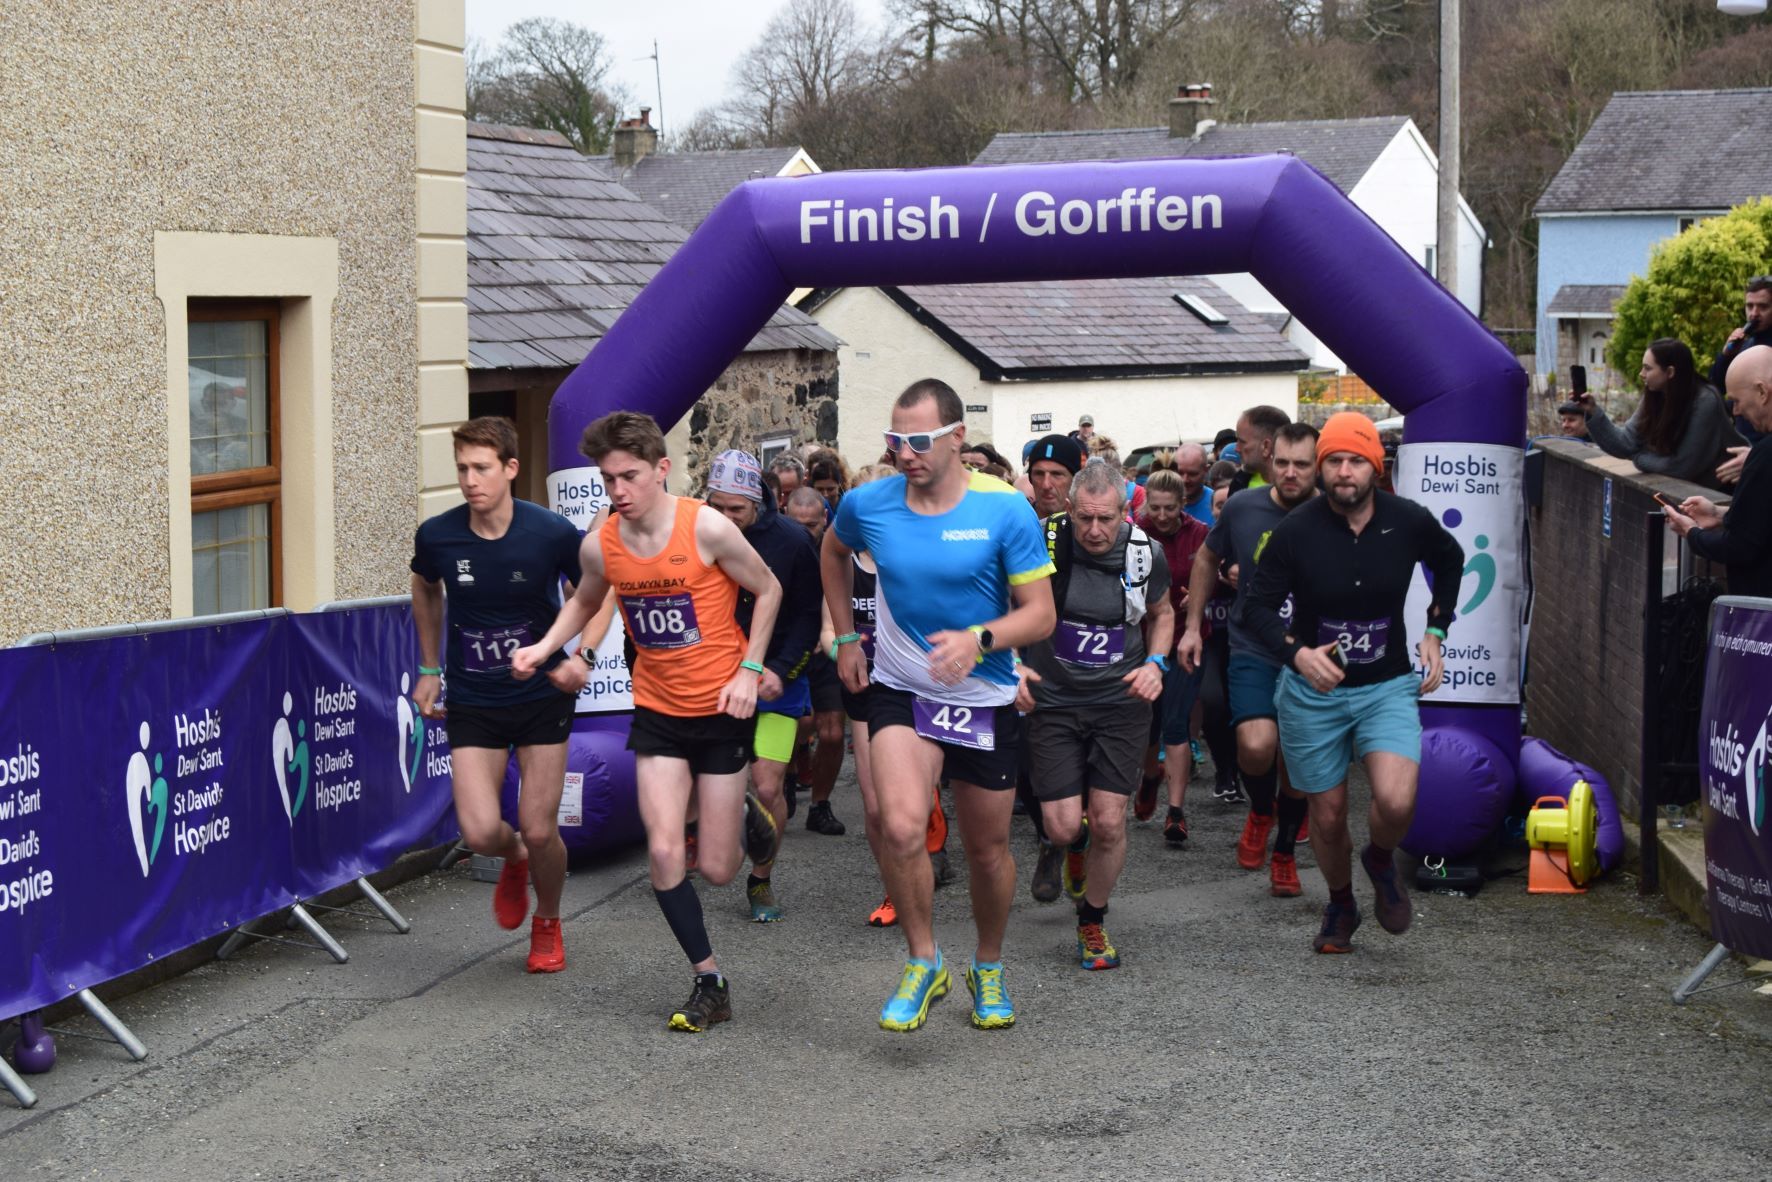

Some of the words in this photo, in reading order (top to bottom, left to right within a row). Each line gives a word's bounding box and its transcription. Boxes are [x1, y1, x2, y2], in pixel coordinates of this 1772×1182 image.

[800, 196, 960, 244] Finish
[979, 192, 998, 243] /
[1014, 187, 1223, 237] Gorffen
[1424, 455, 1497, 477] Hosbis
[1421, 478, 1459, 493] Dewi
[1464, 479, 1500, 496] Sant
[557, 501, 585, 517] Dewi
[619, 579, 661, 591] COLWYN
[664, 577, 686, 588] BAY
[634, 609, 686, 634] 108
[471, 639, 521, 661] 112
[1076, 631, 1109, 655] 72
[1337, 633, 1372, 653] 34
[1412, 663, 1496, 690] Hspice
[315, 682, 357, 716] Hosbis
[174, 708, 221, 748] Hosbis
[314, 720, 334, 742] Dewi
[335, 718, 355, 738] Sant
[931, 705, 972, 734] 42
[1709, 720, 1745, 776] Hosbis
[177, 752, 200, 778] Dewi
[199, 747, 224, 771] Sant
[315, 755, 324, 776] St
[324, 749, 354, 773] David's
[18, 788, 41, 817] Sant
[173, 793, 186, 816] St
[187, 782, 224, 812] David's
[315, 776, 361, 812] Hospice
[1721, 782, 1739, 820] Sant
[174, 813, 230, 856] Hospice
